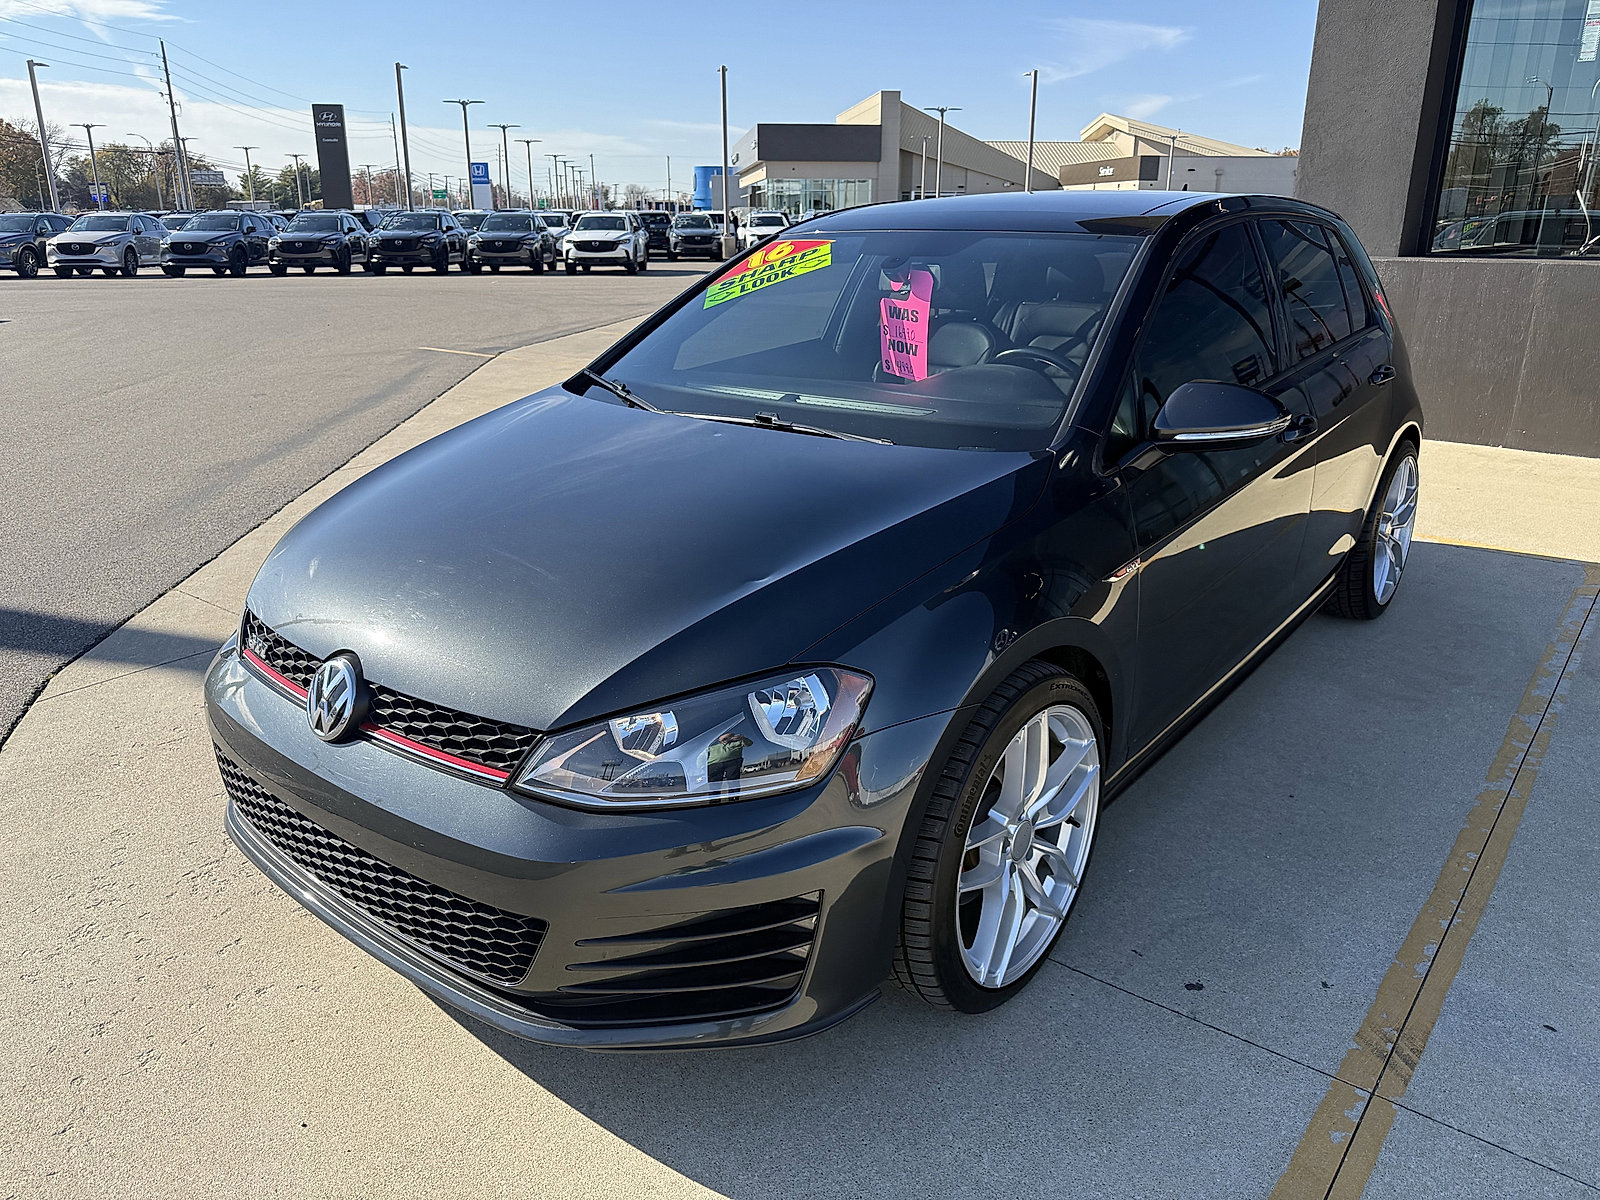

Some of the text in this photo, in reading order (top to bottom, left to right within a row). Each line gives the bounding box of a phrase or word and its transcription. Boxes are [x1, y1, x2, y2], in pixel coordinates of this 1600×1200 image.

[718, 248, 820, 290] SHARP
[747, 241, 795, 269] 16
[739, 265, 797, 293] LOOK
[888, 305, 919, 322] WAS
[888, 338, 918, 356] NOW
[953, 761, 987, 838] Continental
